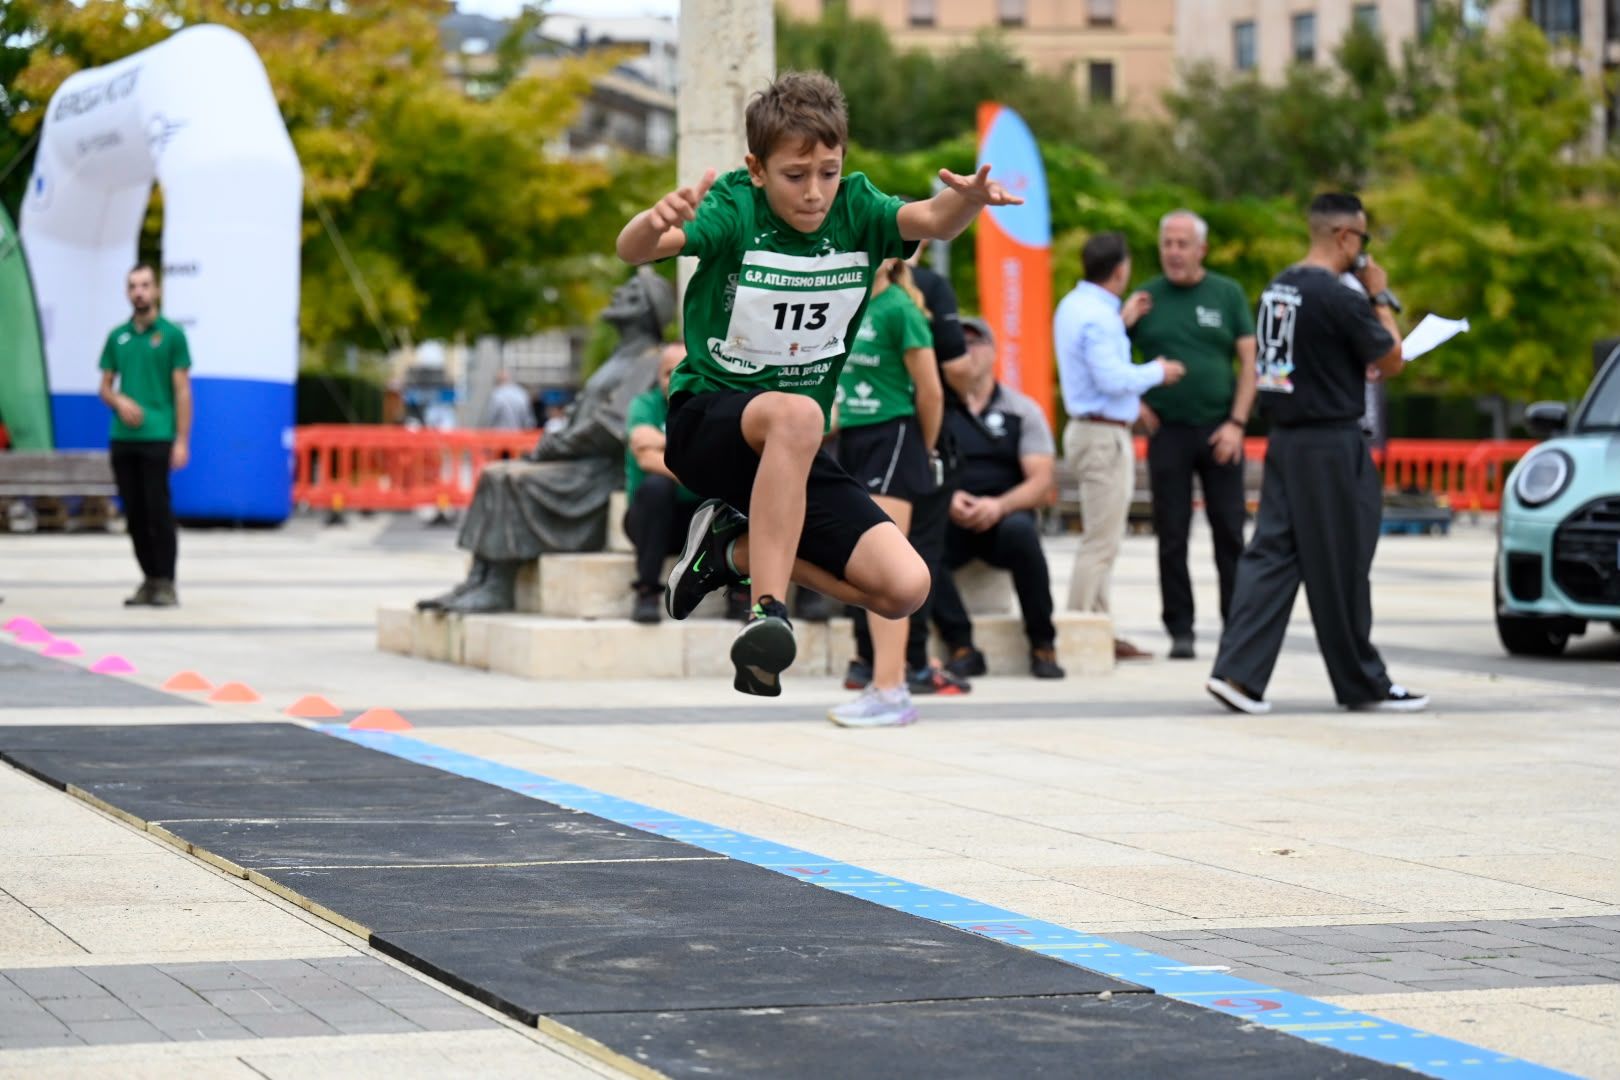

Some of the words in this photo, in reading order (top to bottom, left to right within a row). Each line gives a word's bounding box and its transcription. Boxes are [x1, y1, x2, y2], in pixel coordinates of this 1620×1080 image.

[745, 270, 763, 283] G.P.
[764, 273, 814, 287] ATLETISMO
[814, 276, 826, 287] EN
[827, 275, 838, 286] LA
[838, 272, 863, 284] CALLE
[773, 302, 830, 331] 113
